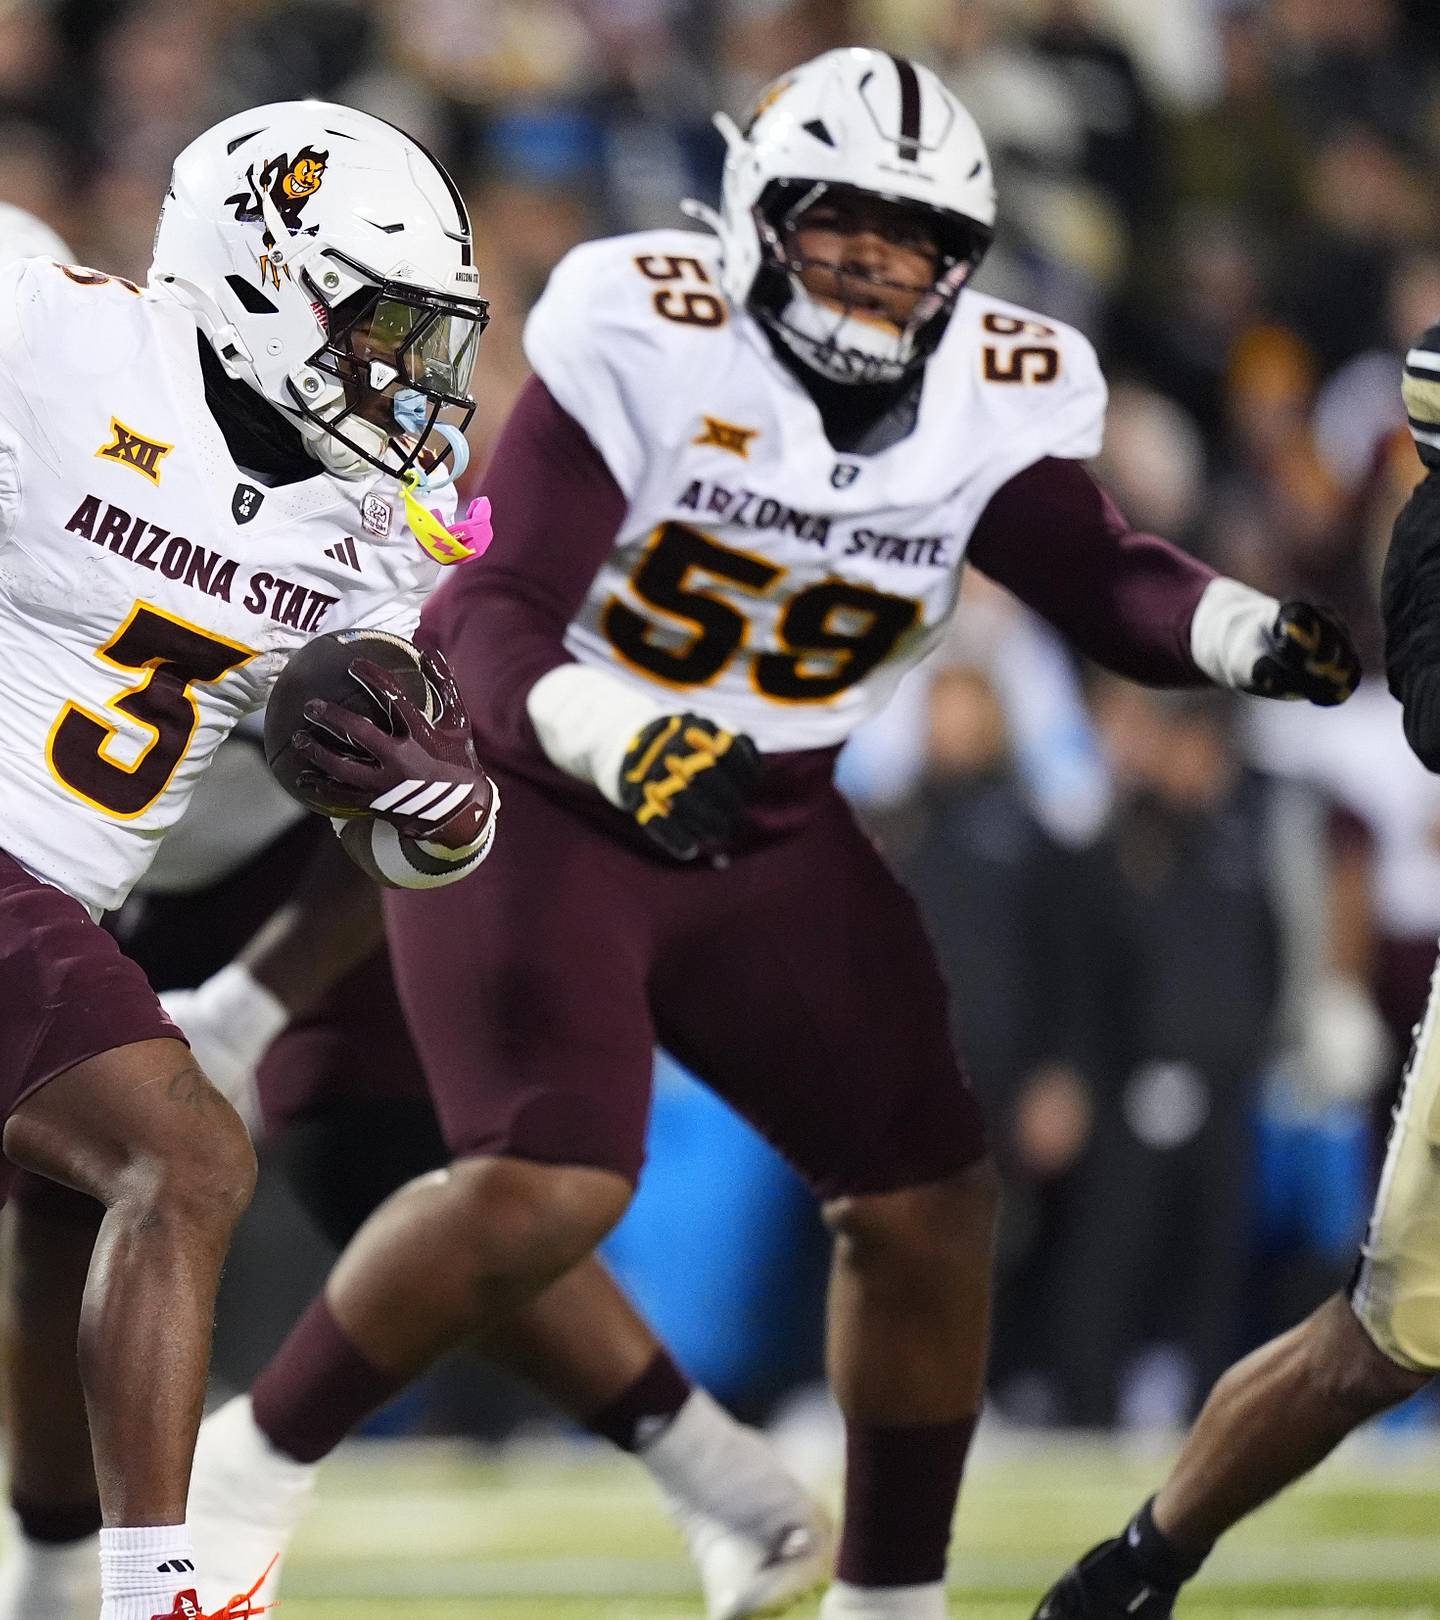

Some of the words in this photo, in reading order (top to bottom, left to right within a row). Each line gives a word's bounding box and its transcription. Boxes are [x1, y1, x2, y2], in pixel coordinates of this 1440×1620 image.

[633, 254, 729, 328] 59
[99, 420, 171, 484] XII
[238, 503, 250, 517] 42
[242, 489, 256, 503] PT
[64, 494, 240, 603] ARIZONA
[243, 571, 341, 633] STATE
[844, 528, 953, 567] STATE
[600, 519, 924, 707] 59
[44, 596, 264, 822] 3
[180, 1596, 197, 1620] AD
